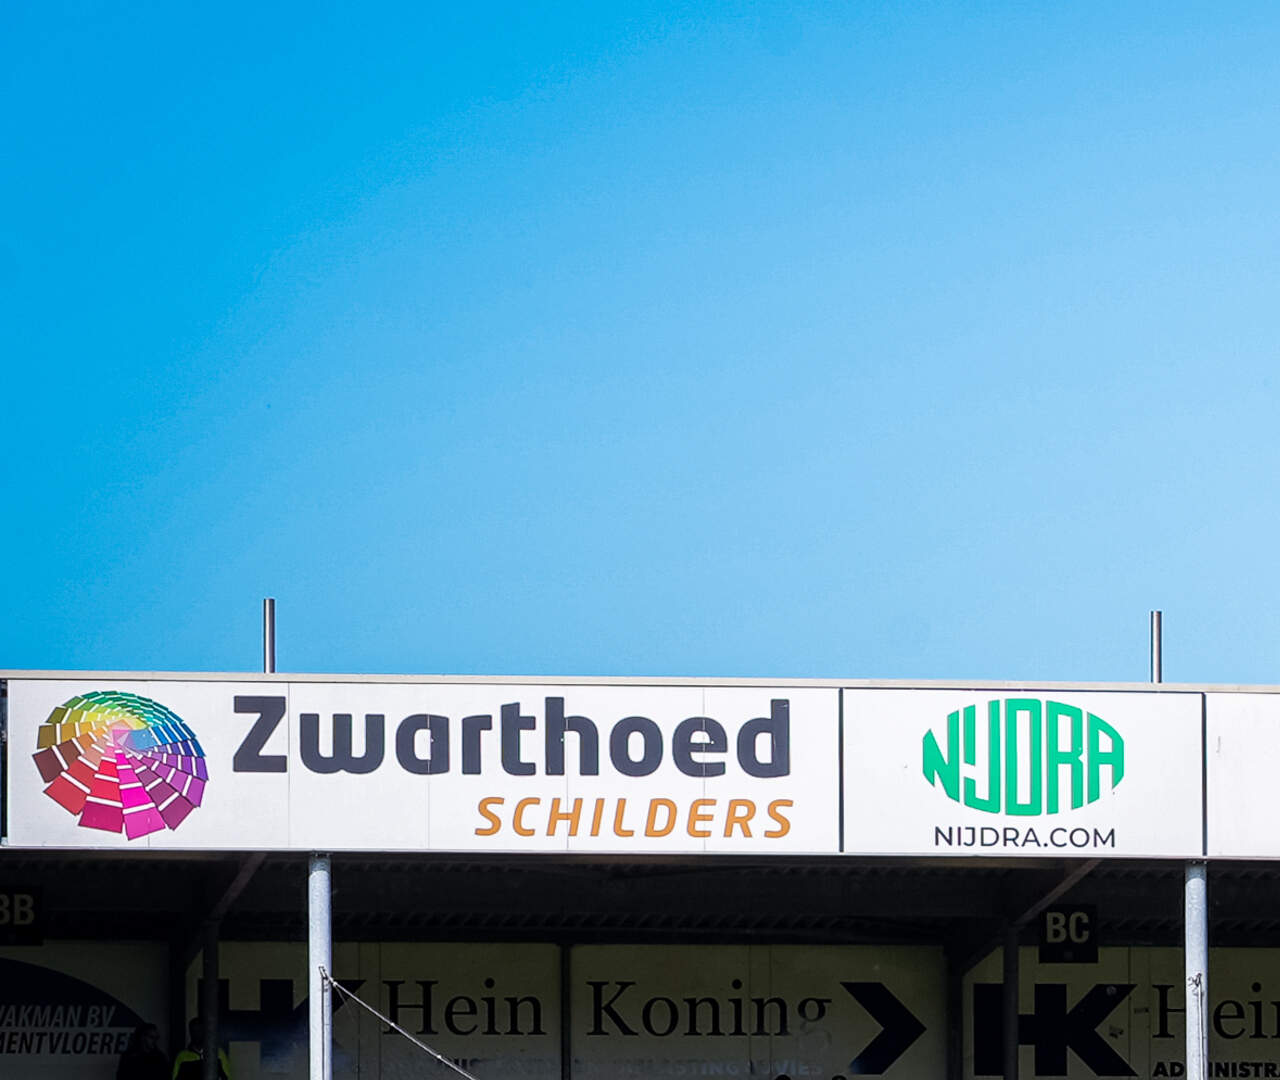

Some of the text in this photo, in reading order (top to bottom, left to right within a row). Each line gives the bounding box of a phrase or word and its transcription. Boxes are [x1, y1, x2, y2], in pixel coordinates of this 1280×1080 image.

[232, 696, 791, 777] Zwarthoed
[474, 797, 793, 839] SCHILDERS
[934, 826, 1117, 848] NIJDRA.COM
[1046, 912, 1088, 944] BC
[0, 1005, 116, 1028] AKMAN BV
[382, 979, 831, 1050] Hein Koning
